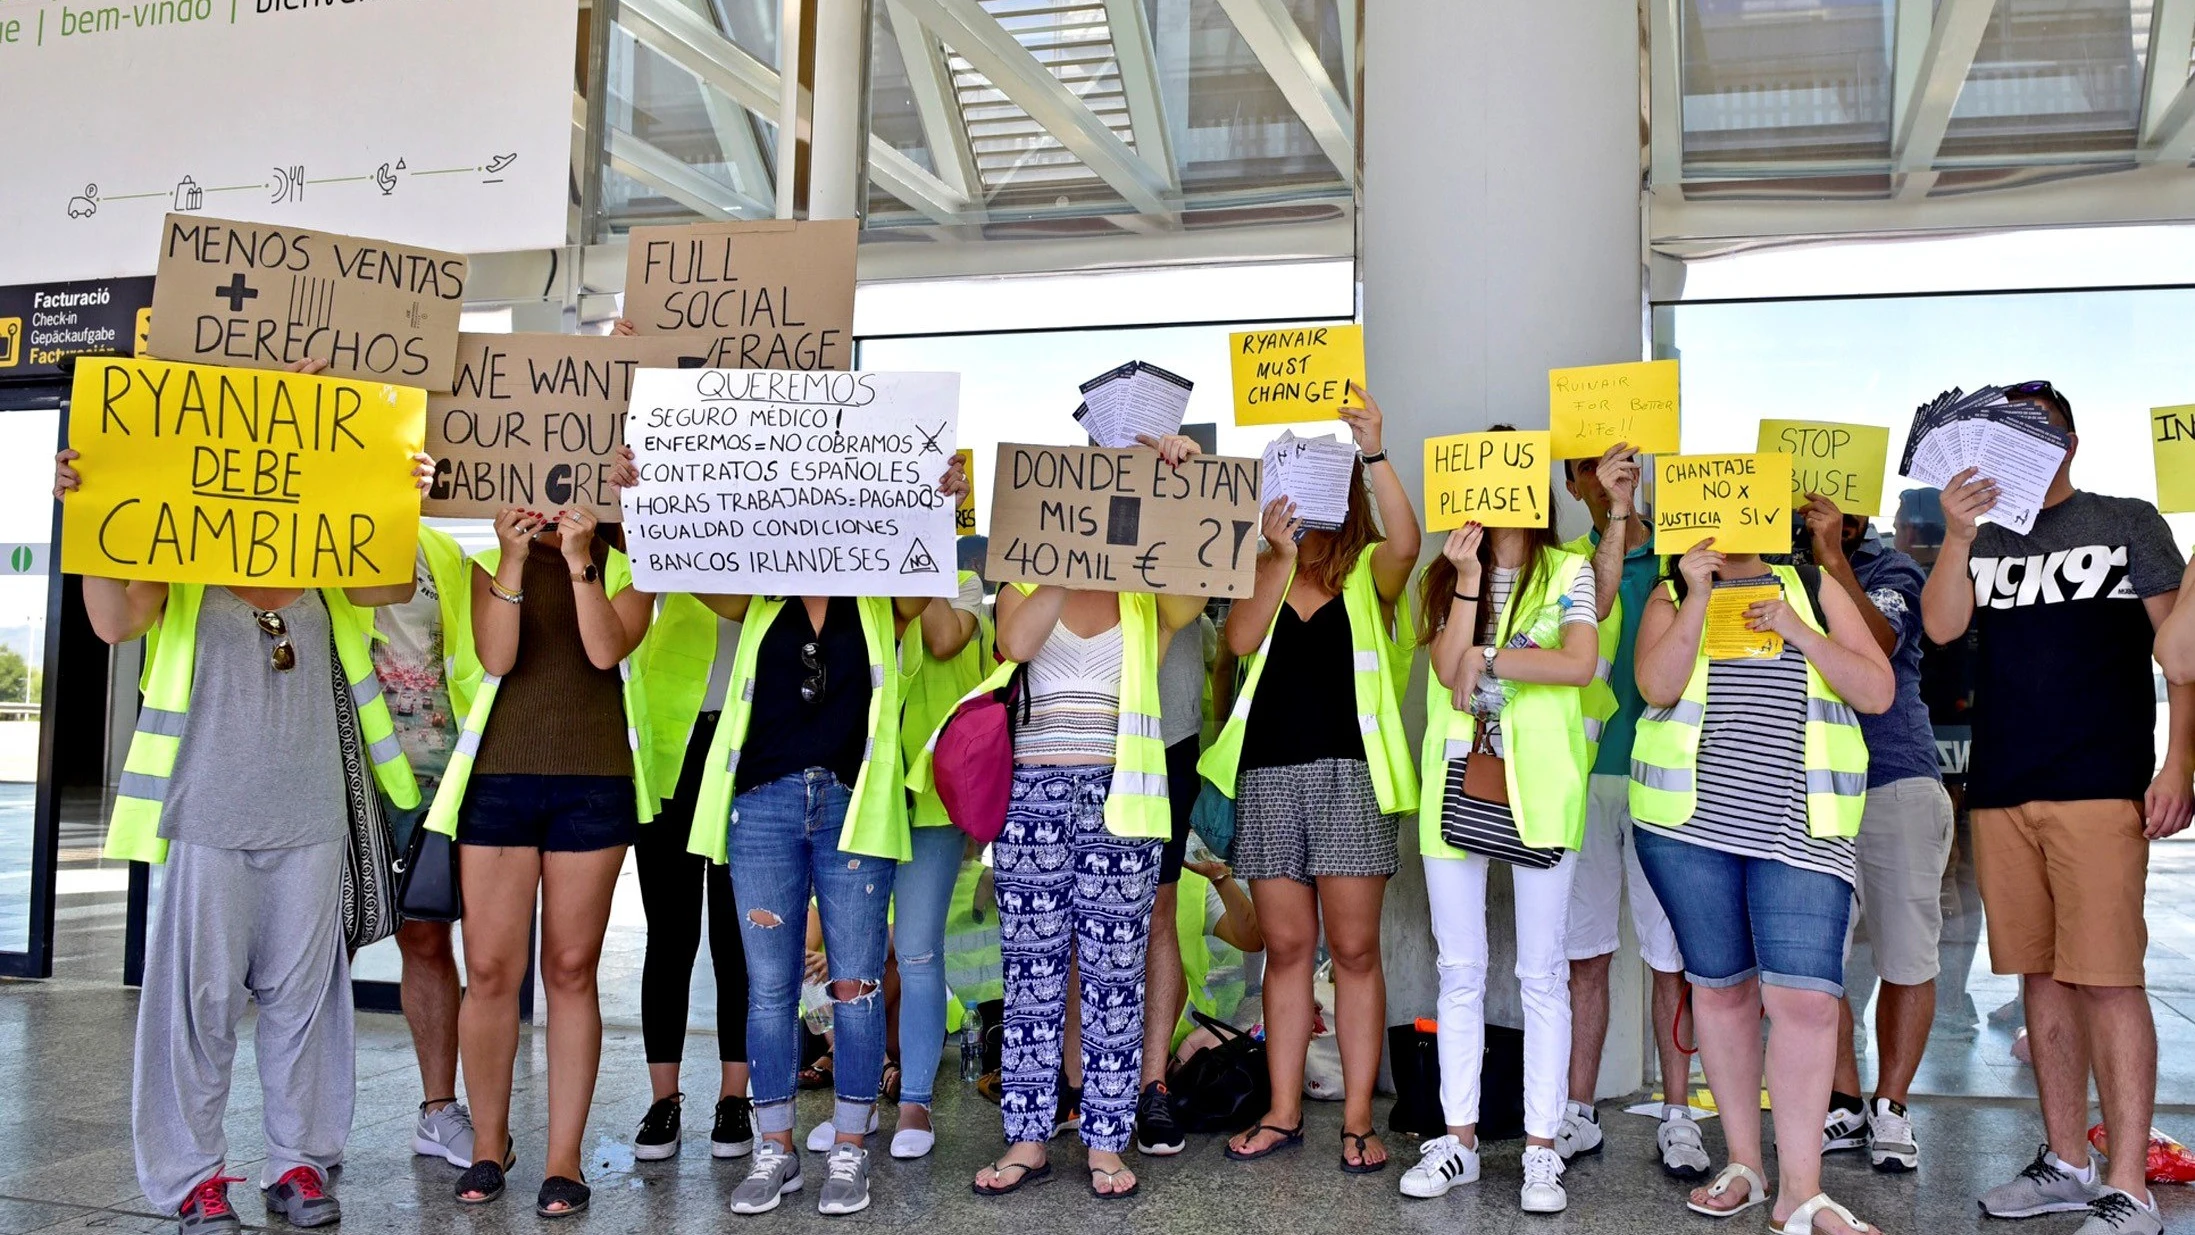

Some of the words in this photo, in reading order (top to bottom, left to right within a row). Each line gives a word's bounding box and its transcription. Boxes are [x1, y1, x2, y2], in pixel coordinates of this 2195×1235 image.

[168, 222, 311, 271] MENOS
[333, 244, 464, 300] VENTAS
[645, 237, 738, 284] FULL
[34, 287, 110, 309] Facturació
[656, 286, 806, 330] SOCIAL
[32, 310, 78, 327] Check-in
[30, 327, 115, 347] Gepäckaufgabe
[194, 315, 429, 376] DERECHOS
[1242, 328, 1327, 354] RYANAIR
[451, 346, 511, 399] WE
[528, 355, 639, 401] WANT
[1256, 354, 1311, 380] MUST
[697, 370, 876, 406] QUEREMOS
[101, 364, 366, 452] RYANAIR
[646, 407, 737, 428] SEGURO
[443, 409, 531, 448] OUR
[644, 434, 752, 453] ENFERMOS
[769, 433, 802, 453] NO
[807, 433, 913, 454] COBRAMOS
[1778, 427, 1851, 459] STOP
[191, 445, 301, 498] DEBE
[640, 460, 778, 483] CONTRATOS
[791, 457, 920, 484] ESPAÑOLES
[1435, 440, 1493, 473] HELP
[1503, 442, 1534, 469] US
[1666, 459, 1756, 483] CHANTAJE
[430, 458, 534, 505] CABIN
[545, 462, 621, 506] CRE
[1013, 450, 1135, 493] DONDE
[1153, 456, 1258, 506] ESTAN
[1703, 480, 1731, 500] NO
[636, 495, 710, 515] HORAS
[716, 487, 847, 511] TRABAJADAS
[1658, 511, 1721, 526] JUSTICIA
[1740, 507, 1759, 525] SI
[640, 519, 744, 540] IGUALDAD
[753, 518, 899, 537] CONDICIONES
[1040, 500, 1098, 536] MIS
[98, 499, 381, 578] CAMBIAR
[650, 551, 739, 572] BANCOS
[750, 548, 890, 573] IRLANDESES
[1004, 537, 1060, 576] 40
[1066, 549, 1117, 581] MIL
[1132, 542, 1167, 588] €
